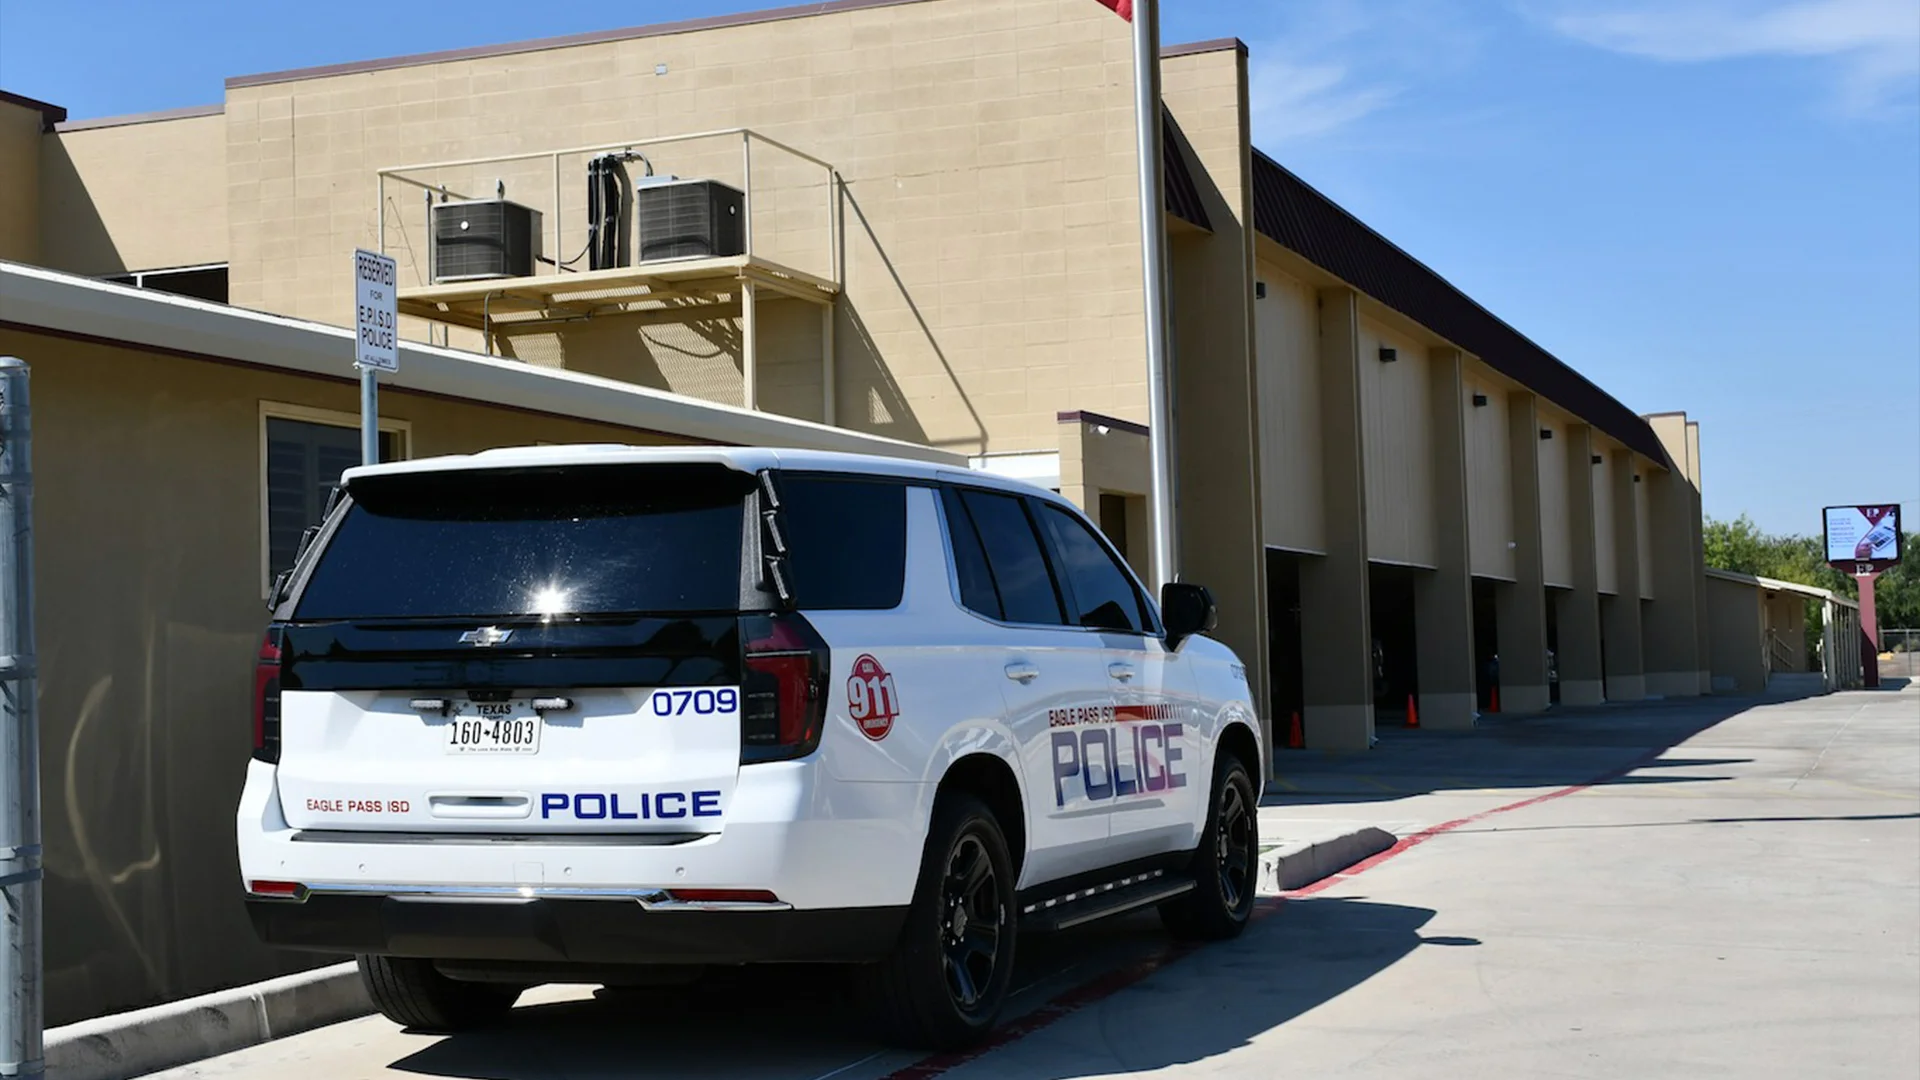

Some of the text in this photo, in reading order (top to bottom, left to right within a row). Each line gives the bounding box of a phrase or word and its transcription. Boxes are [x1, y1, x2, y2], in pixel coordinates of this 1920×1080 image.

[359, 255, 394, 286] RESERVED
[370, 289, 383, 300] FOR
[362, 327, 393, 351] POLICE
[1855, 564, 1875, 576] EP
[652, 689, 738, 717] 0709
[848, 675, 899, 719] 911
[476, 704, 512, 715] TEXAS
[1049, 709, 1077, 727] EAGLE
[1078, 706, 1100, 725] PASS
[1051, 723, 1187, 807] POLICE
[306, 798, 410, 813] EAGLE PASS ISD
[541, 790, 722, 820] POLICE
